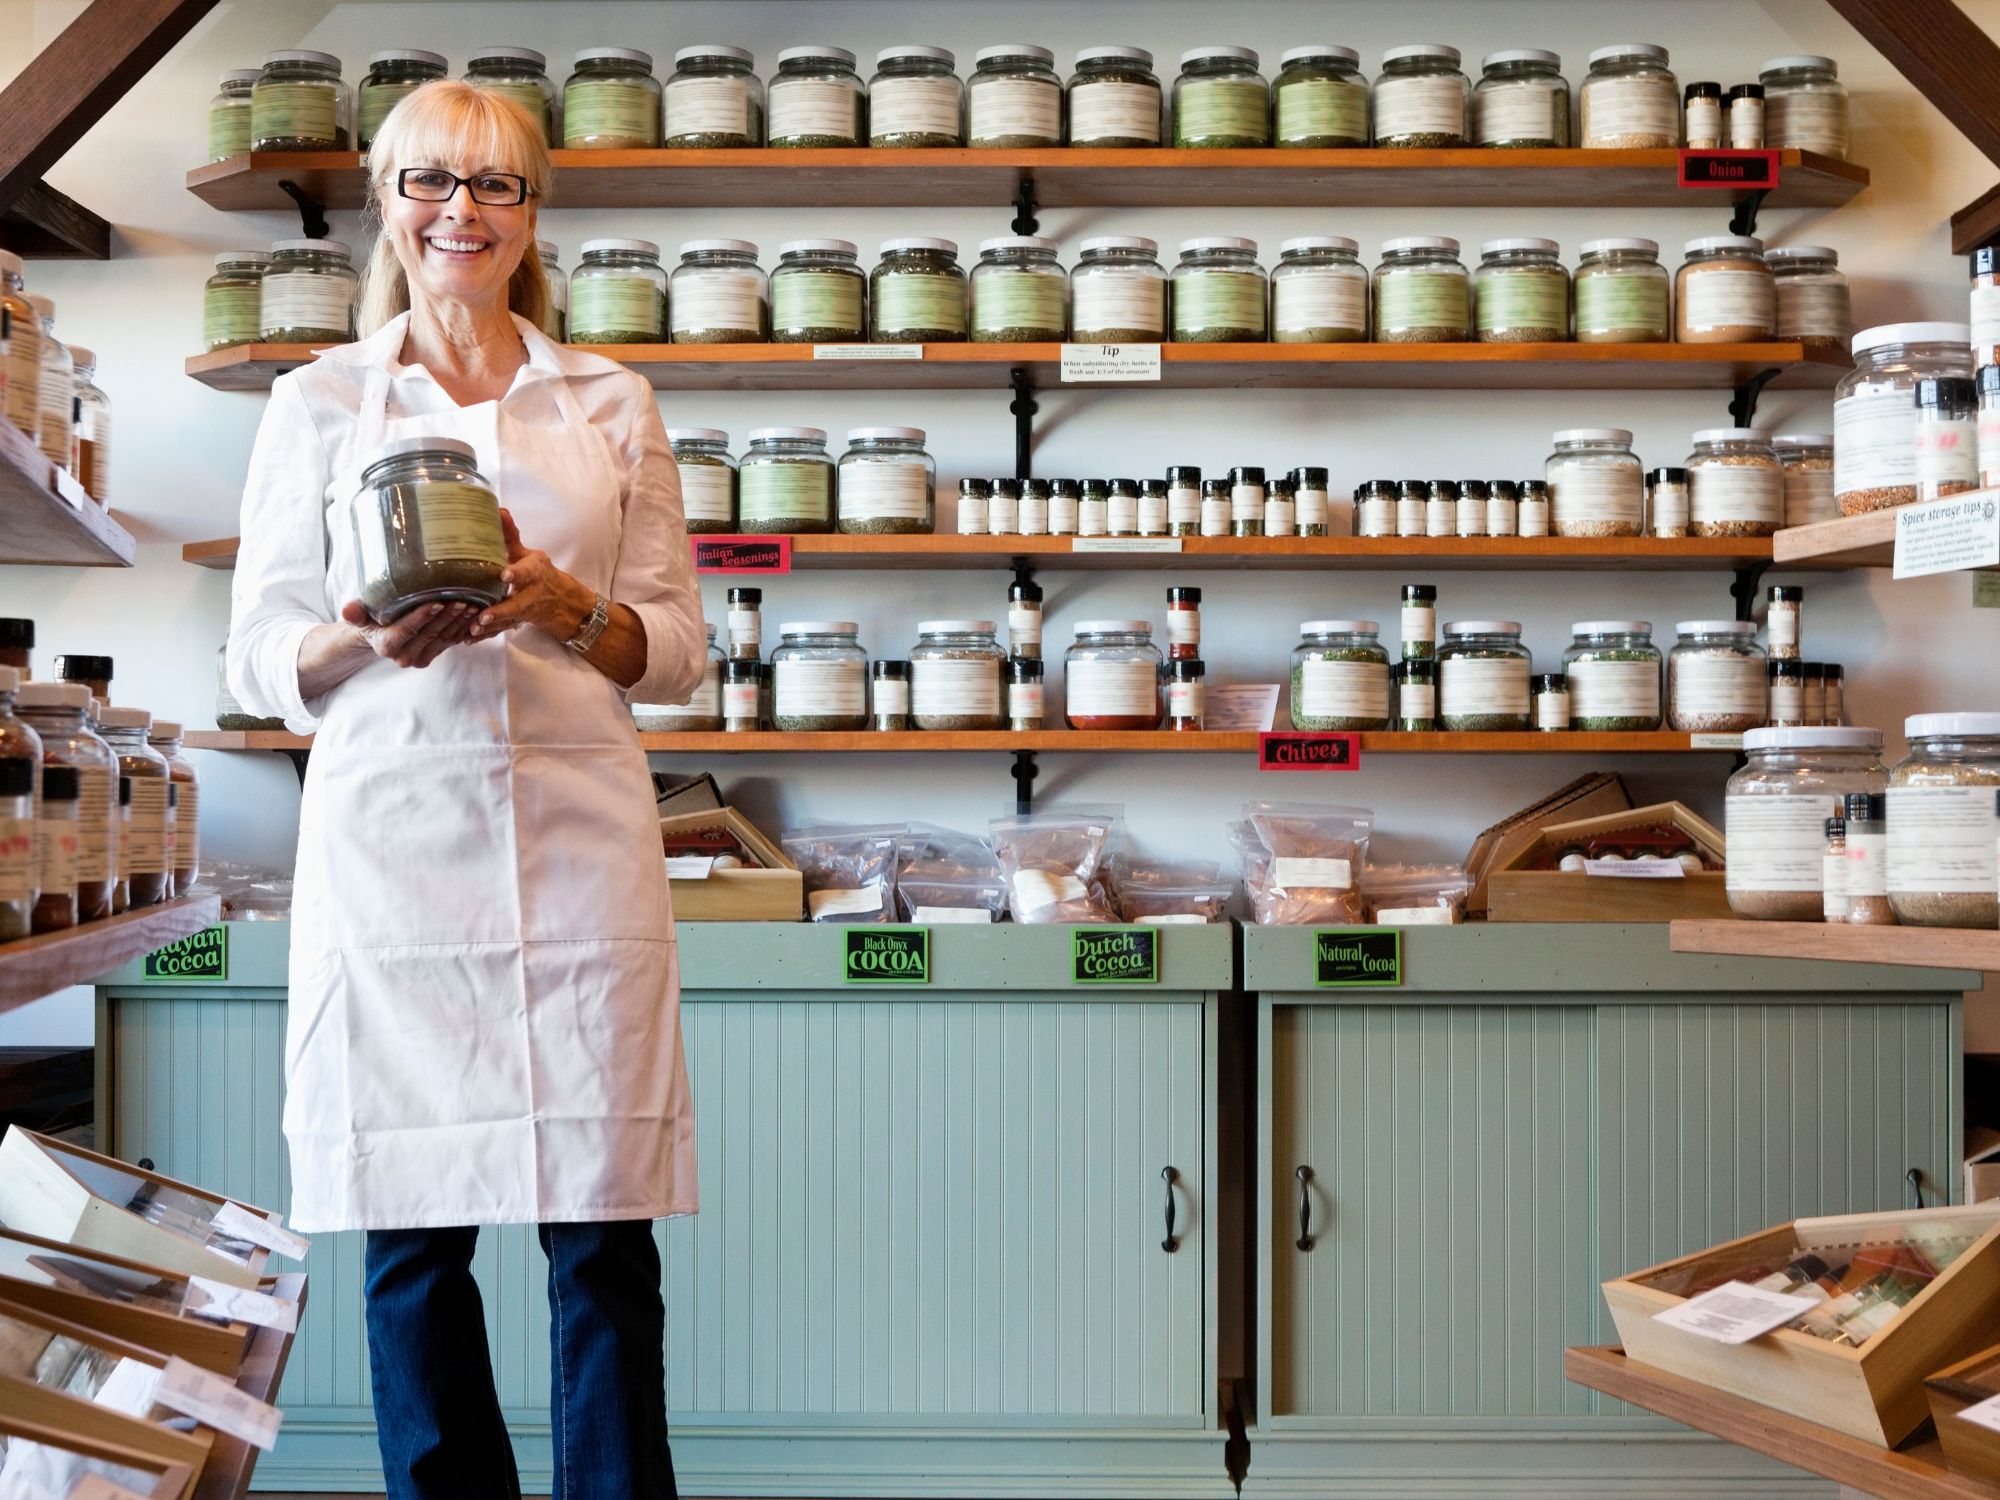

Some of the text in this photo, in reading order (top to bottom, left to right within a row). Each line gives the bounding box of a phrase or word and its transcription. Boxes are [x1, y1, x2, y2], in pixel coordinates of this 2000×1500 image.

[1709, 160, 1744, 177] Onion
[1101, 345, 1120, 357] Tip
[1082, 360, 1118, 368] substituting
[1902, 500, 1981, 528] Spice storage tips
[699, 548, 734, 560] Italian
[721, 551, 779, 567] Seasonings
[1276, 743, 1340, 762] Chives
[864, 937, 908, 951] Black Onyx
[1076, 933, 1136, 958] Dutch
[1319, 942, 1362, 961] Natural
[155, 950, 220, 975] Cocoa
[848, 950, 924, 970] COCOA
[1084, 952, 1144, 974] Cocoa
[1362, 953, 1396, 972] Cocoa
